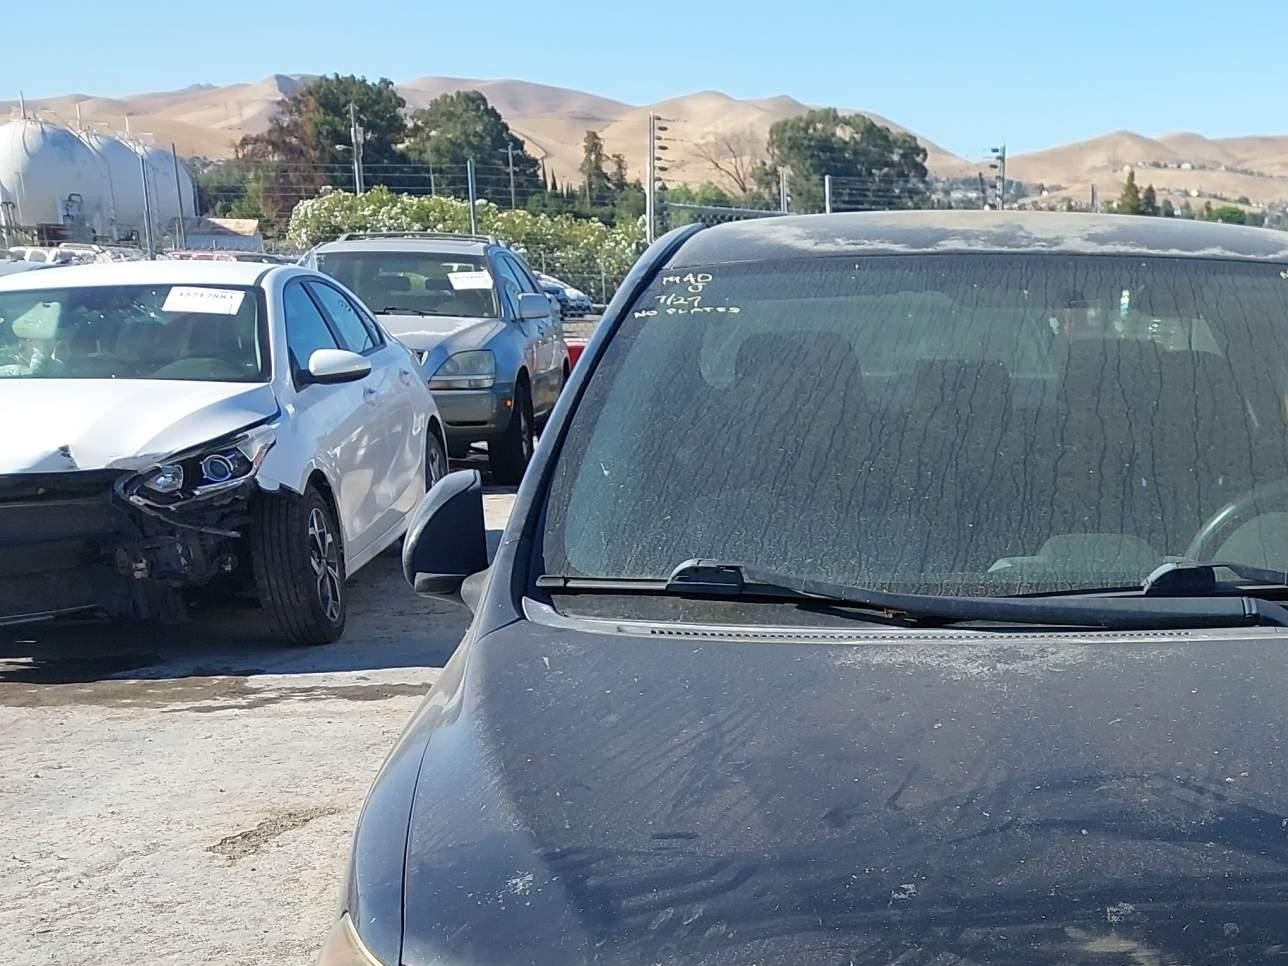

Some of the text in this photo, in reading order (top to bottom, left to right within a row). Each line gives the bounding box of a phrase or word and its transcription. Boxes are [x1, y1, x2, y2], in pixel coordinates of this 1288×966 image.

[655, 293, 702, 307] 7/27
[633, 306, 741, 319] NO PLATES
